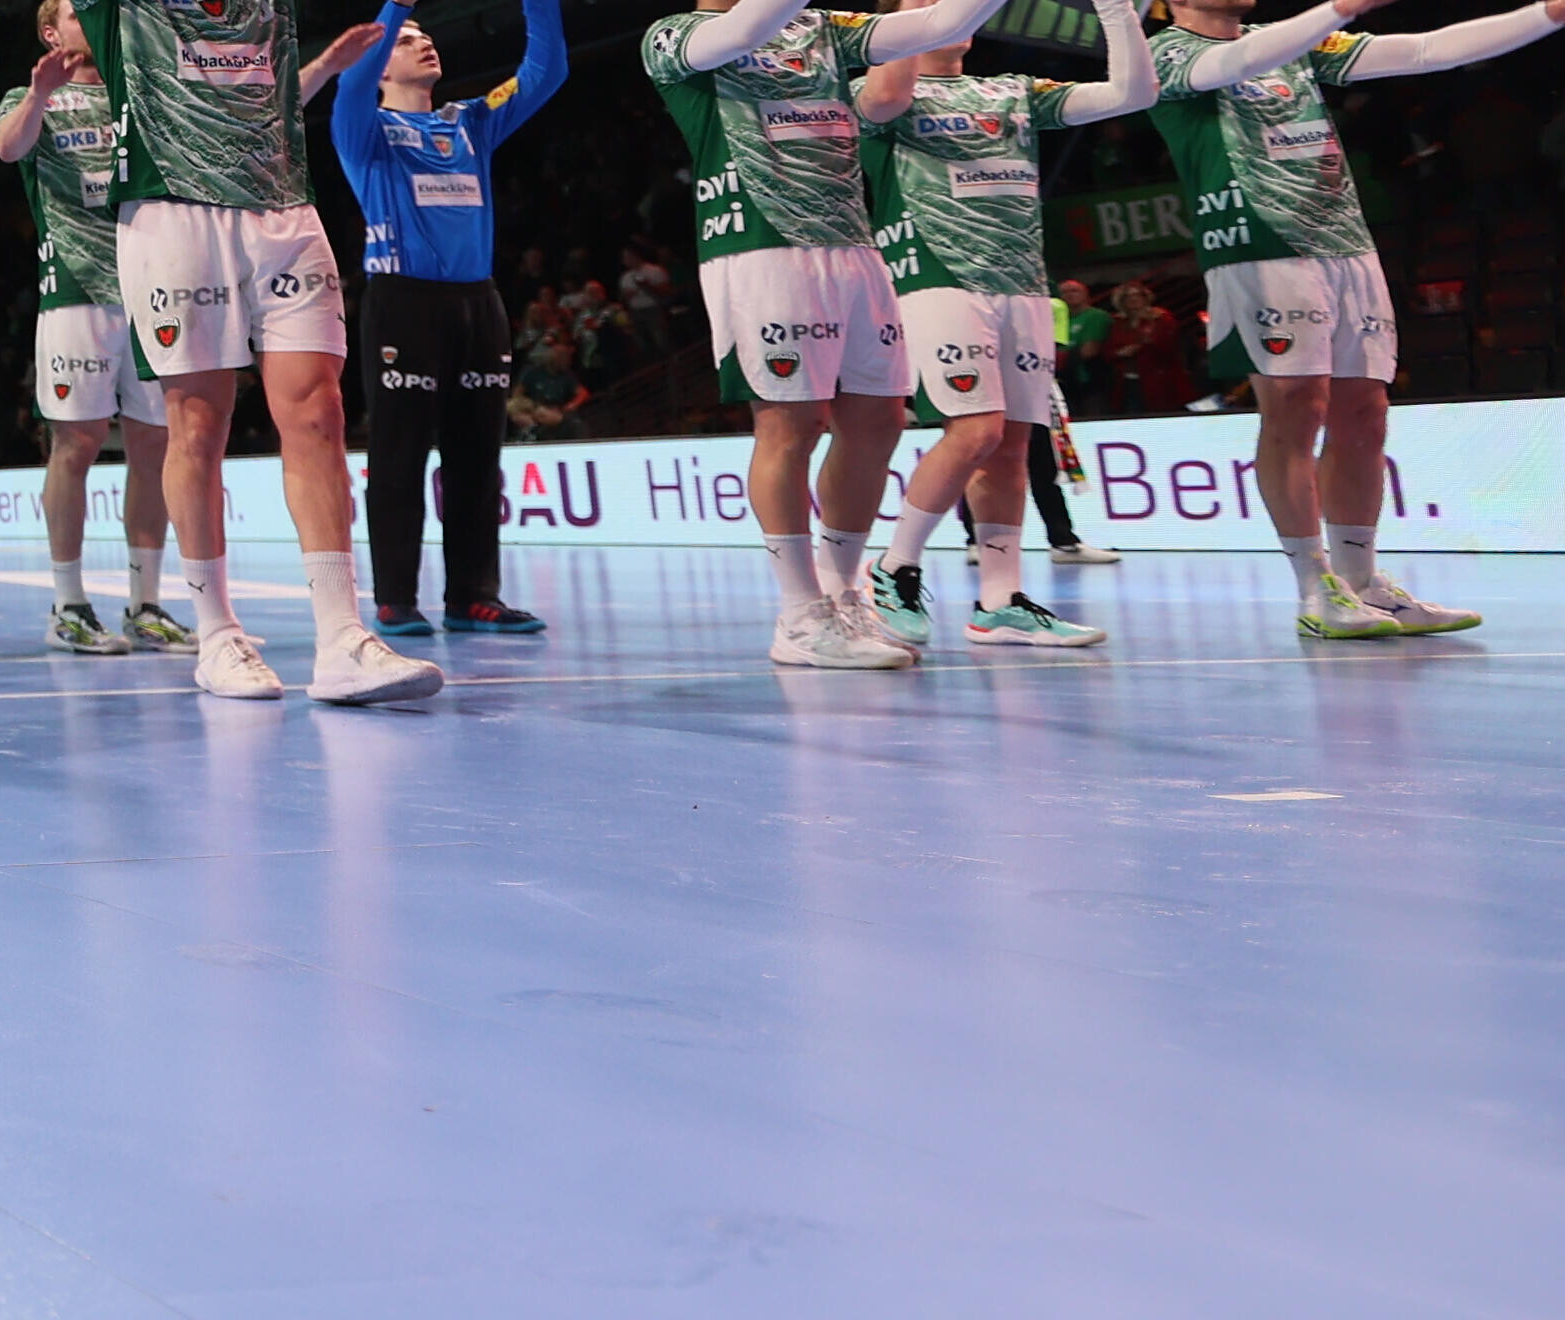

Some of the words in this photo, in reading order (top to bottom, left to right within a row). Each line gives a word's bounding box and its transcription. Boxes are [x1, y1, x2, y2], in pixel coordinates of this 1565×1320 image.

[55, 130, 98, 150] DKB
[696, 161, 740, 203] avi
[874, 211, 915, 249] avi
[1202, 217, 1251, 251] avi
[173, 287, 230, 306] PCH
[792, 322, 840, 341] PCH
[69, 358, 110, 374] PCH
[646, 455, 748, 523] Hie
